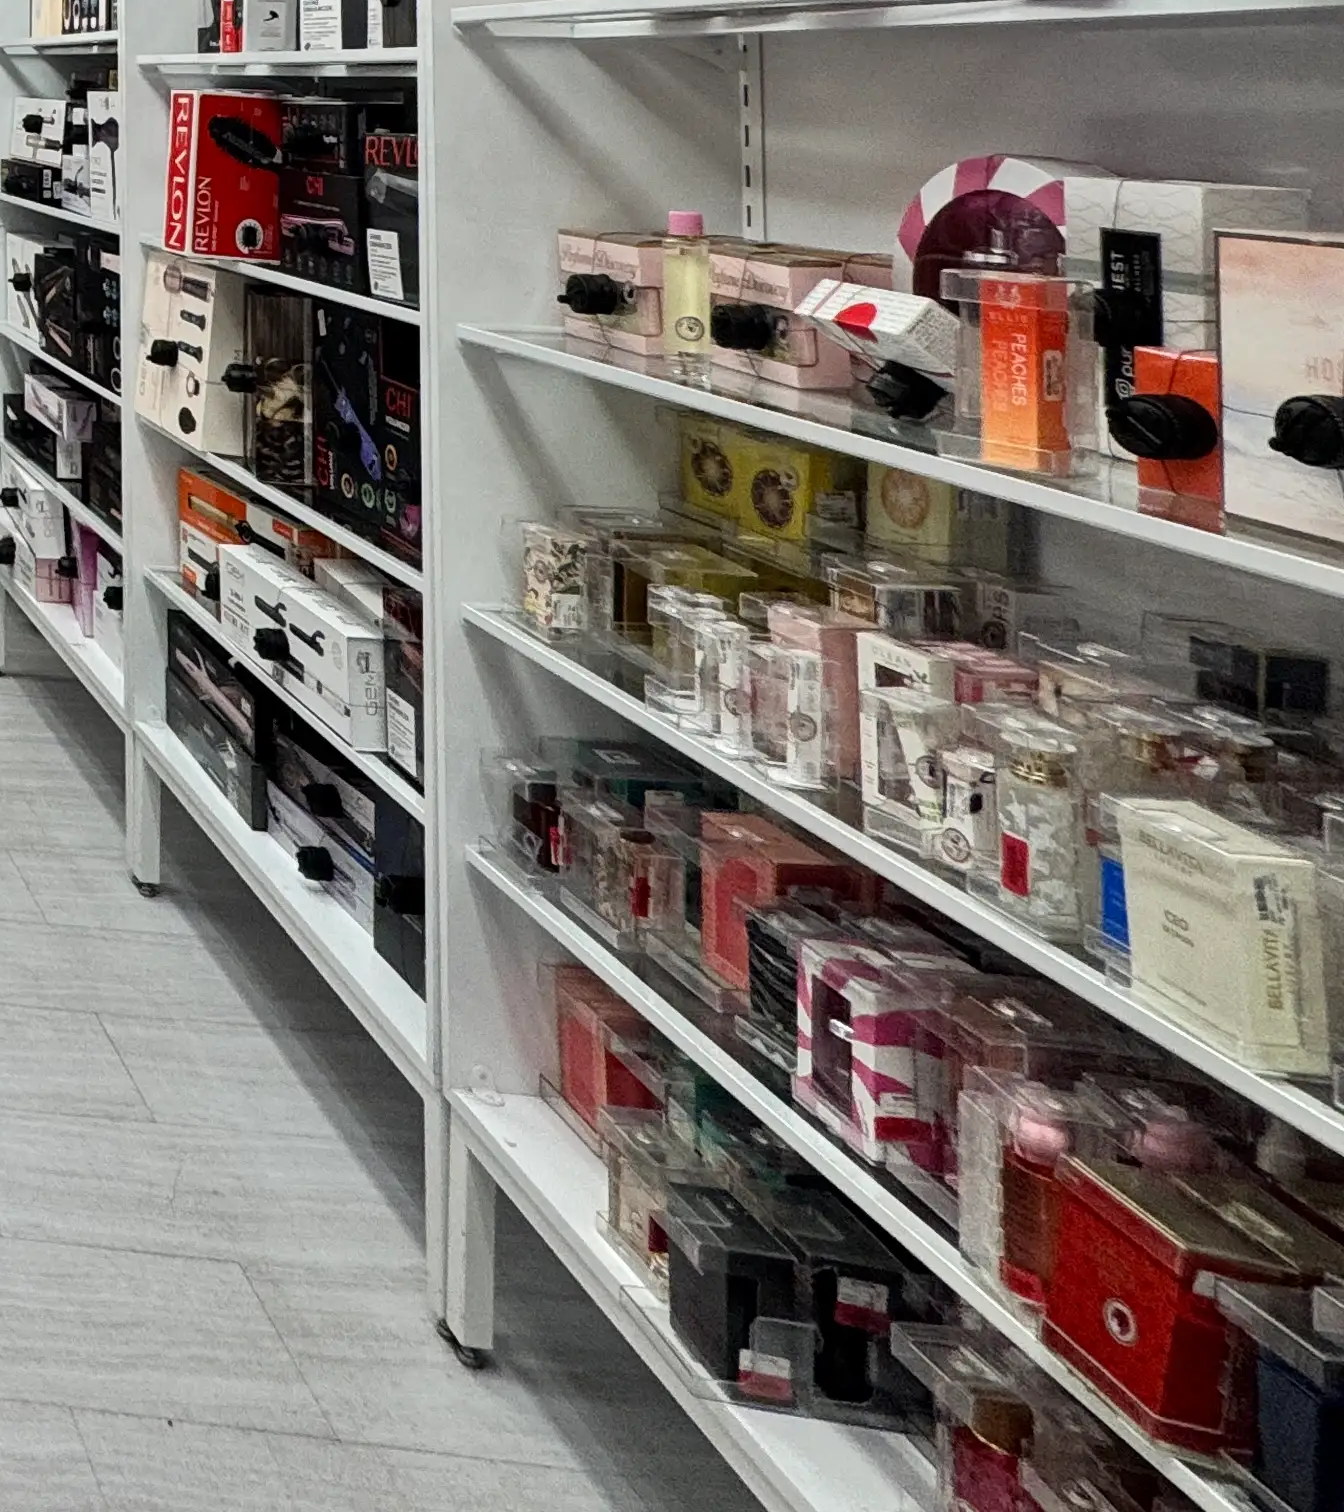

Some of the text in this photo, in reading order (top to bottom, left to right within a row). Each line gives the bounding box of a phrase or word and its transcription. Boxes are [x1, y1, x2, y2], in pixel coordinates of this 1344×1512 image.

[168, 97, 190, 248] REVLON
[365, 135, 417, 169] REVL
[195, 176, 213, 252] REVLON
[1111, 249, 1126, 291] EST
[1010, 331, 1029, 408] PEACHES
[385, 386, 412, 419] CHI
